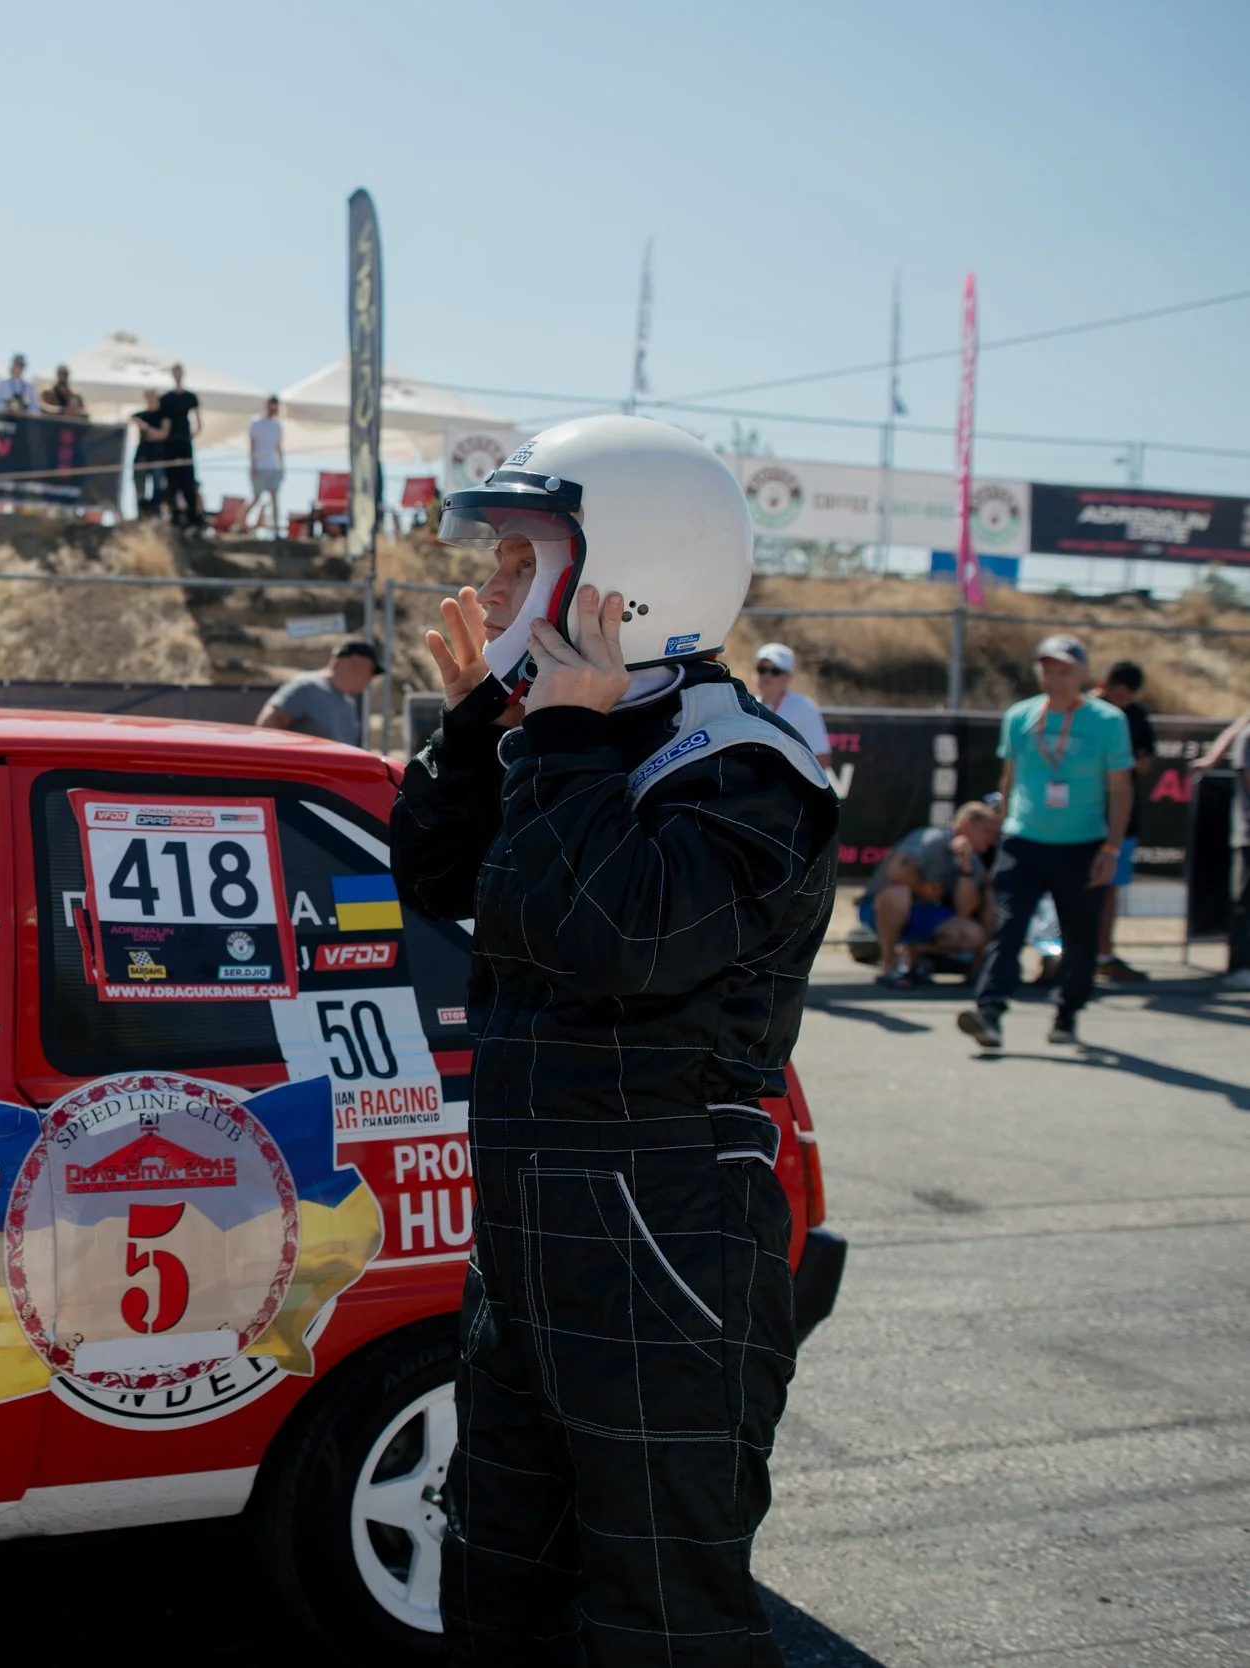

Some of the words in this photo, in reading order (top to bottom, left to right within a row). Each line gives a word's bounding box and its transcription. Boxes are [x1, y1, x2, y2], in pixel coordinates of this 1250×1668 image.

[138, 815, 170, 825] DRAG
[171, 816, 214, 827] RACING
[108, 838, 259, 919] 418
[110, 925, 174, 937] ADRENALIN
[132, 933, 166, 943] DRIVE
[129, 966, 164, 976] BARDAHL
[105, 985, 292, 999] WWW.DRAGUKRAINE.COM
[316, 1000, 399, 1081] 50
[360, 1085, 439, 1116] RACING
[57, 1099, 121, 1150] SPEED
[127, 1093, 179, 1112] LINE
[186, 1099, 243, 1143] CLUB
[393, 1139, 474, 1185] PRO
[120, 1202, 189, 1334] 5
